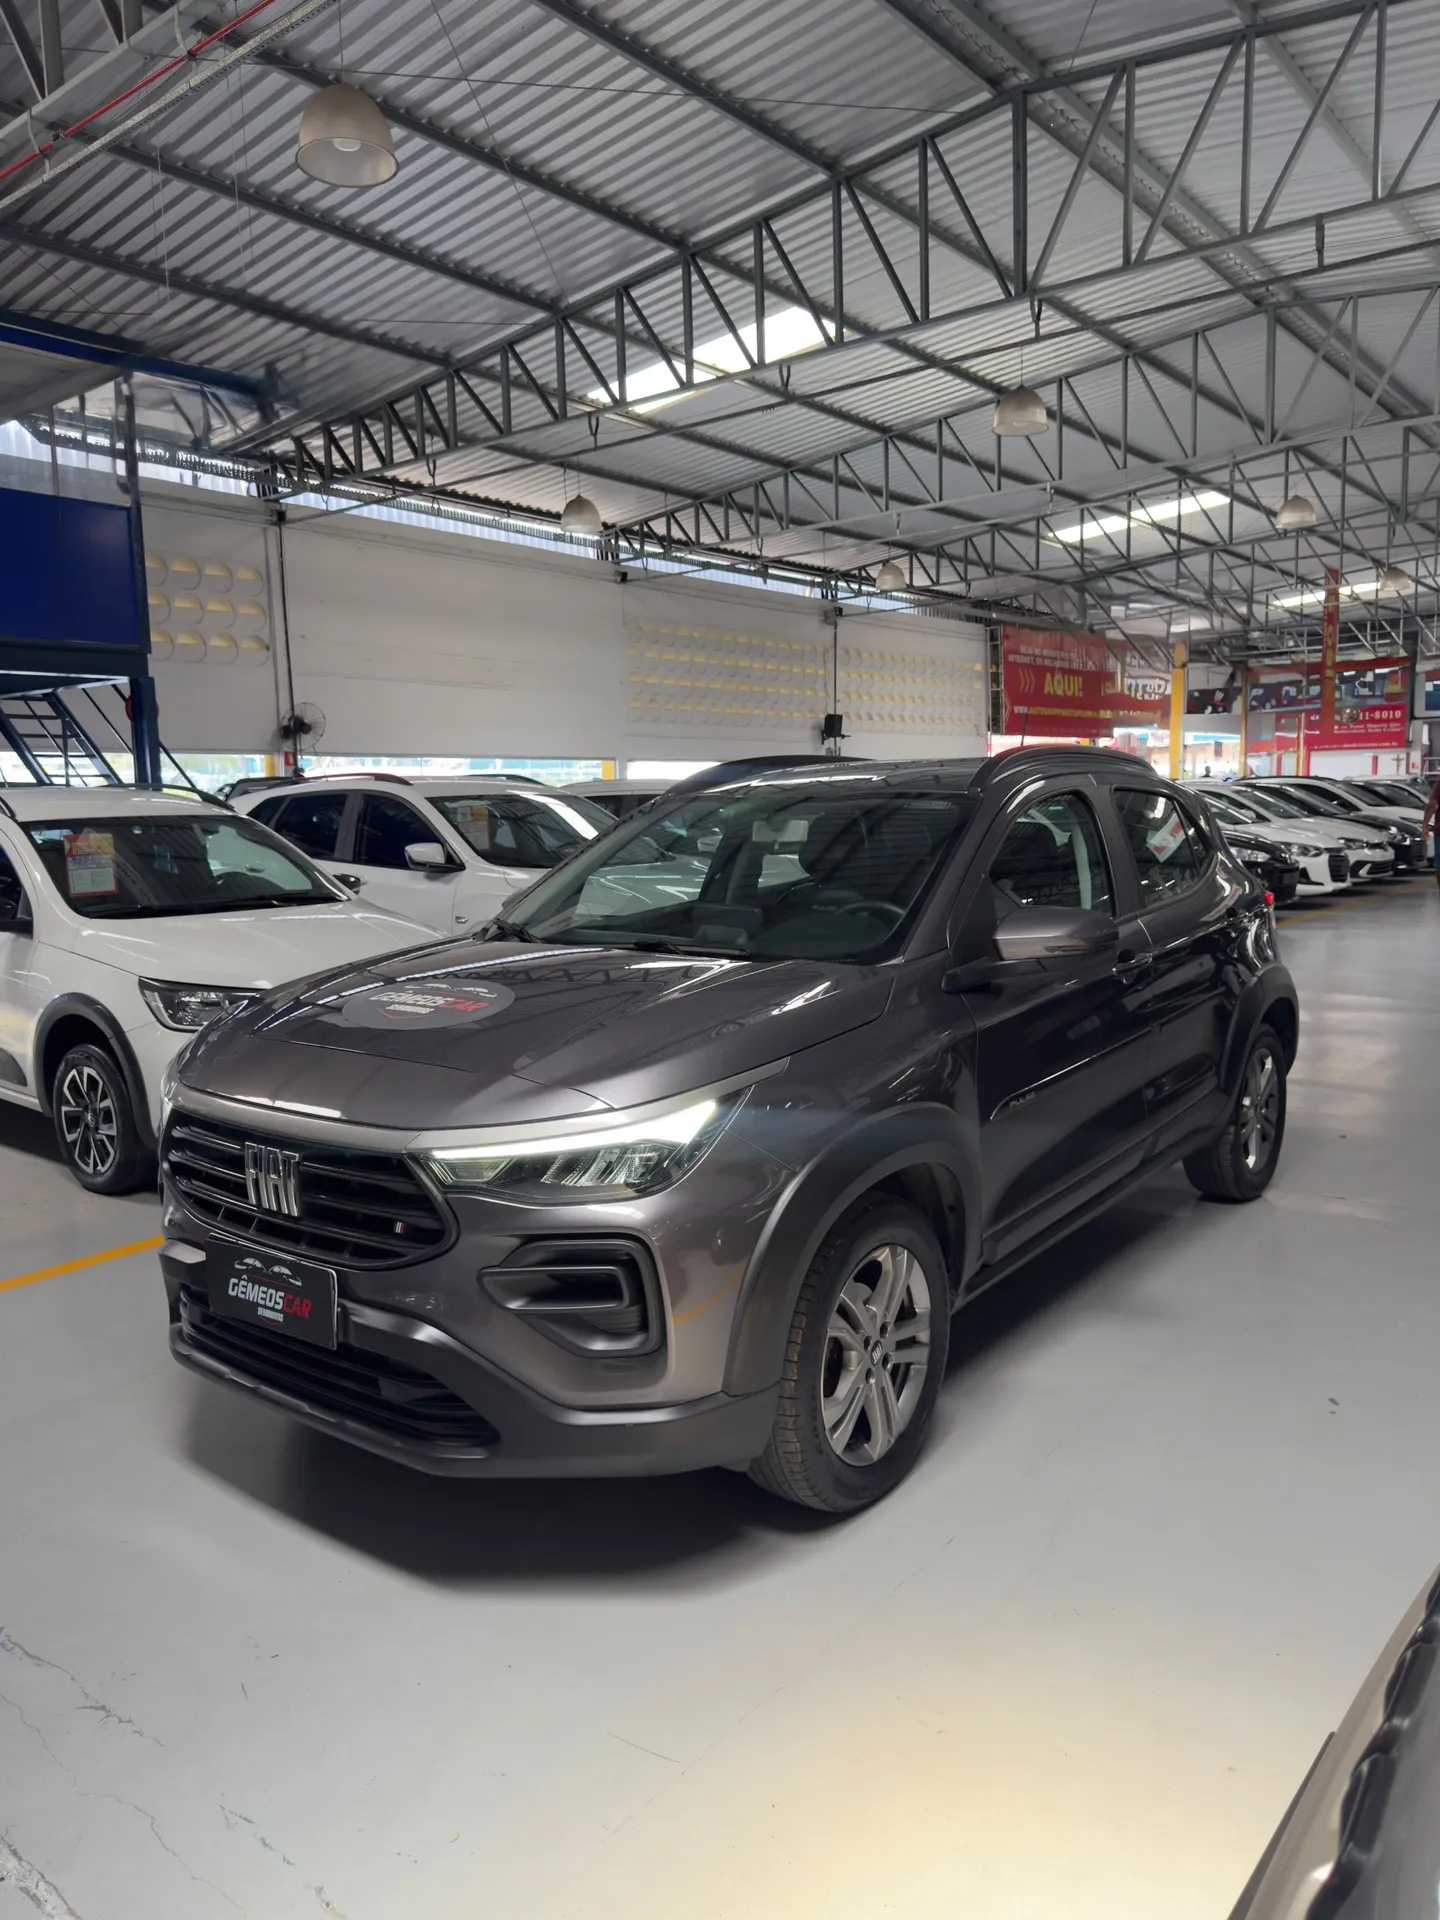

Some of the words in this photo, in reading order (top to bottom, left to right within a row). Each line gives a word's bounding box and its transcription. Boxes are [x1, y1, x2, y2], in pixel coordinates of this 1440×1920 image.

[1044, 671, 1083, 697] AQUI!
[1359, 709, 1402, 721] 11-8010
[1009, 1090, 1036, 1109] PULSE
[245, 1142, 300, 1217] FIAT
